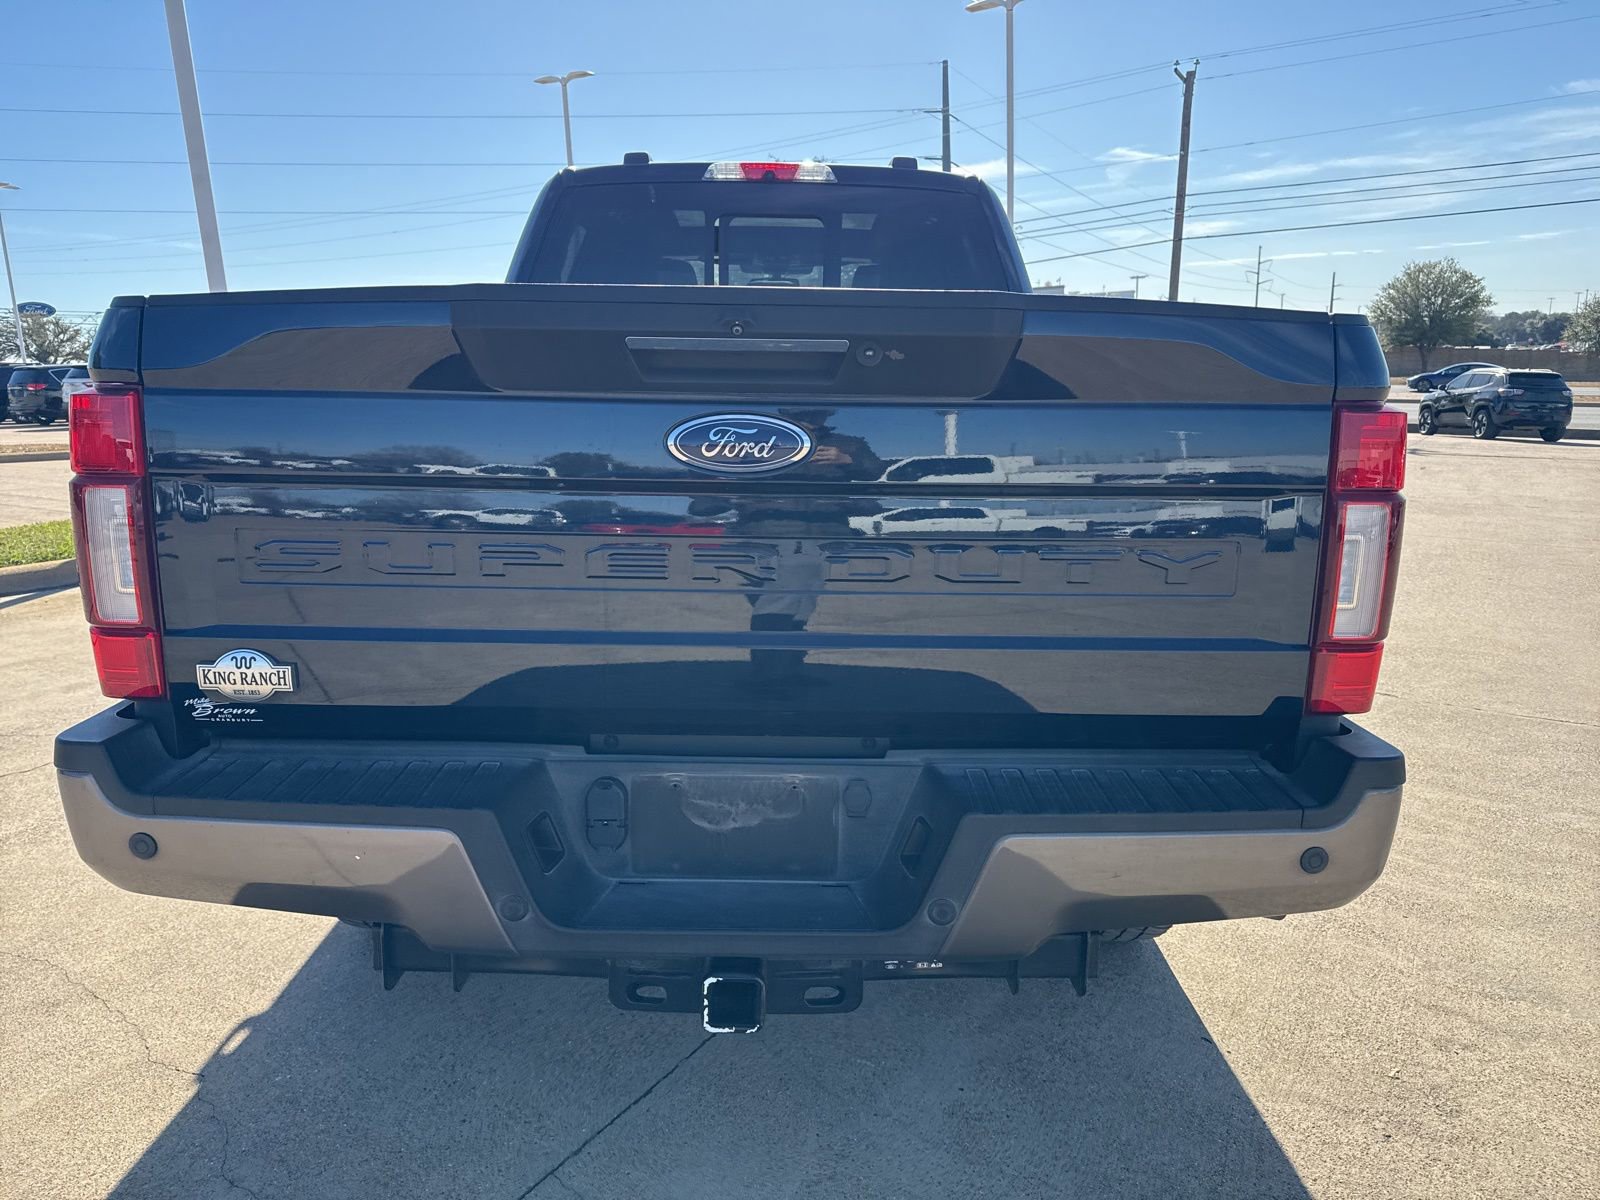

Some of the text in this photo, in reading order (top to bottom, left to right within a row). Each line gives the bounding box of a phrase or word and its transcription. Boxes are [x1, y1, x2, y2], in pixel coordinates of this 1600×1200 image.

[23, 305, 48, 314] Ford
[701, 426, 777, 458] Ford
[255, 539, 1224, 585] SUPER DUTY
[201, 668, 288, 687] KING RANCH
[191, 704, 258, 717] Brown
